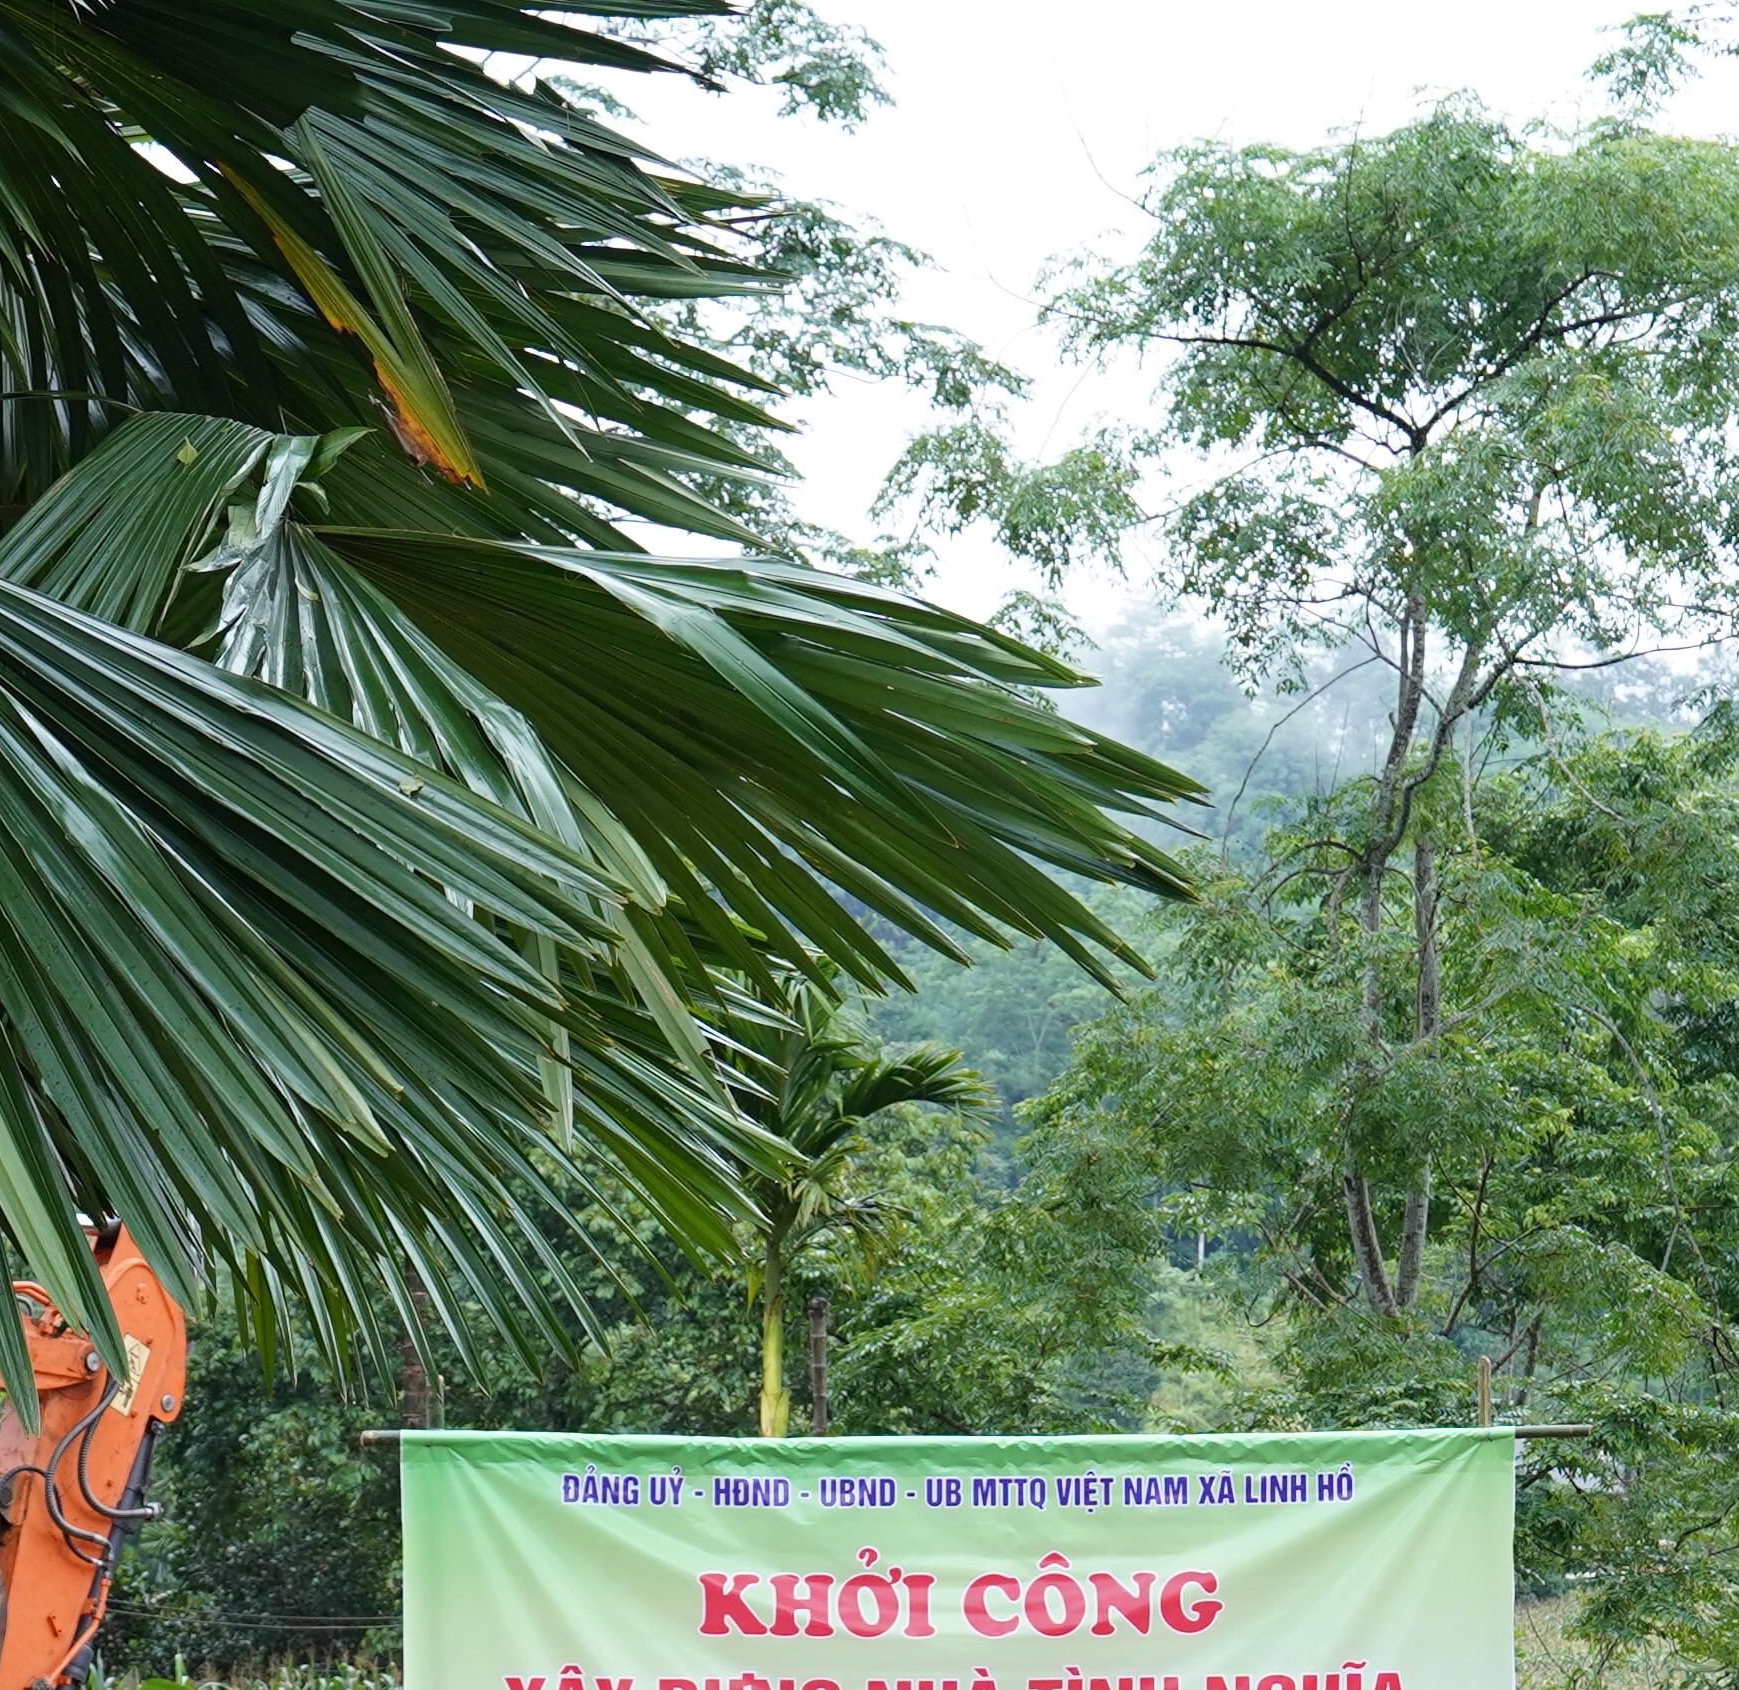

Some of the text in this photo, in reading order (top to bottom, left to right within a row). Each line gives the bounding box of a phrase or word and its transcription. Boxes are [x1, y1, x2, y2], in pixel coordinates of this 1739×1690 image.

[562, 1465, 640, 1506] ĐẢNG
[649, 1466, 685, 1506] UỶ
[713, 1478, 790, 1507] HĐND
[819, 1478, 896, 1507] UBND
[925, 1477, 963, 1507] UB
[972, 1478, 1047, 1510] MTTQ
[1056, 1472, 1115, 1513] VIỆT
[1124, 1476, 1189, 1506] NAM
[1198, 1469, 1236, 1506] XÃ
[1245, 1473, 1308, 1504] LINH
[1317, 1463, 1354, 1502] HỒ
[699, 1548, 1224, 1638] KHỞI CÔNG
